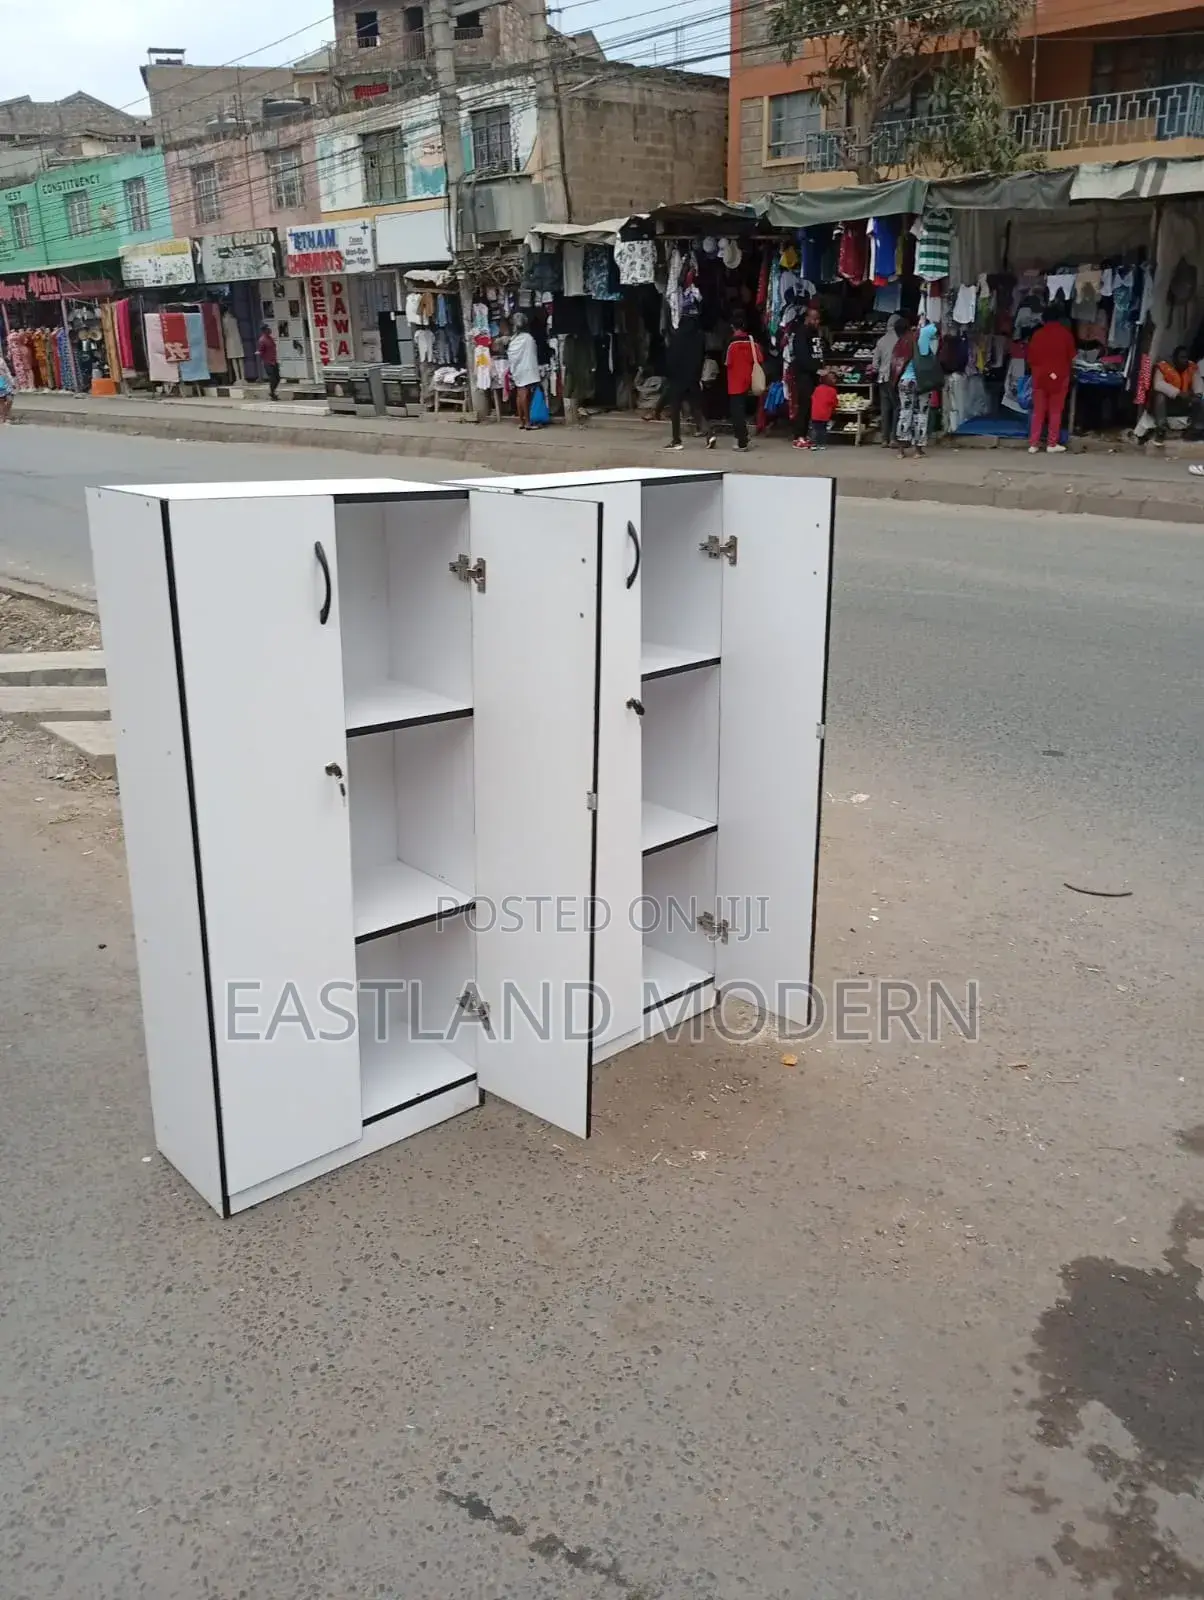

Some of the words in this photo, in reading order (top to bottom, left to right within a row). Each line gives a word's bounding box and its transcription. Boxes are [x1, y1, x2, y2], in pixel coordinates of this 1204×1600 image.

[42, 174, 100, 194] CONSTITUENCY
[310, 276, 330, 366] CHEMIST
[331, 281, 350, 355] DAWA
